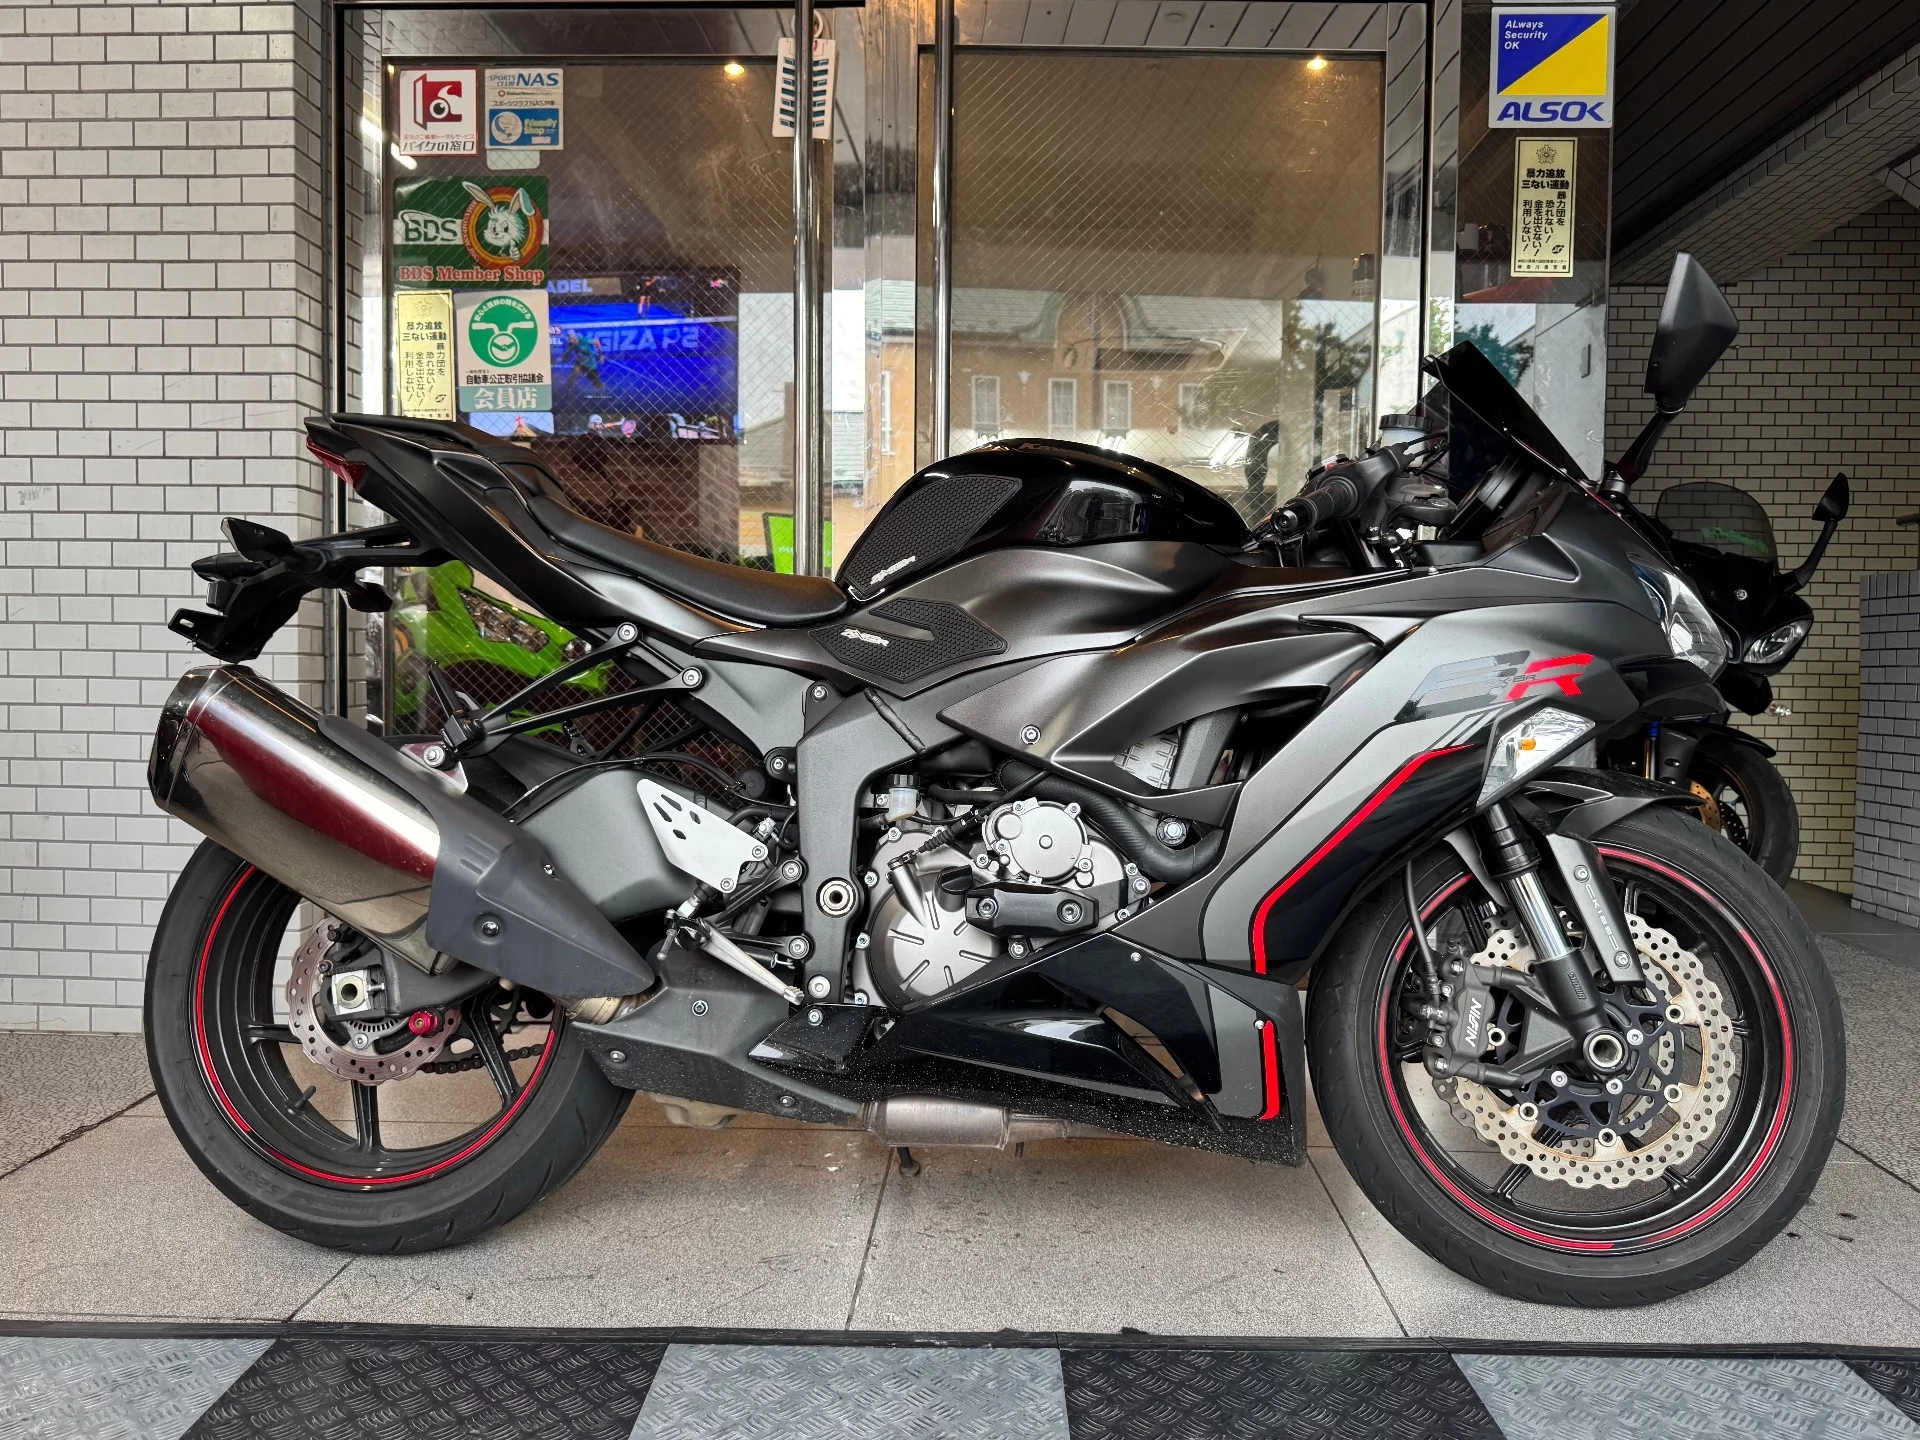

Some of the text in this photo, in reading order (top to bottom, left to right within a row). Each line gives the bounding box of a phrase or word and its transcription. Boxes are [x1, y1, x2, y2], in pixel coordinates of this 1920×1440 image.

[1505, 21, 1544, 30] ALways
[1505, 31, 1548, 41] Security
[1504, 41, 1520, 50] OK
[516, 72, 559, 87] NAS
[1496, 101, 1605, 122] ALSOK
[524, 118, 557, 128] Friendly
[524, 127, 545, 136] Shop
[402, 141, 475, 152] バイクの窓口
[1526, 168, 1565, 178] 暴力追放
[1521, 179, 1569, 189] 三ない運動
[1556, 191, 1566, 226] 暴力団を
[403, 216, 458, 241] BDS
[400, 265, 544, 284] BDS Member Shop
[407, 322, 443, 330] 暴力追放
[402, 332, 447, 341] 三ない運動
[437, 343, 446, 376] 暴力団を
[466, 373, 544, 385] 自動車公正取引協議会
[474, 387, 538, 409] 会員店
